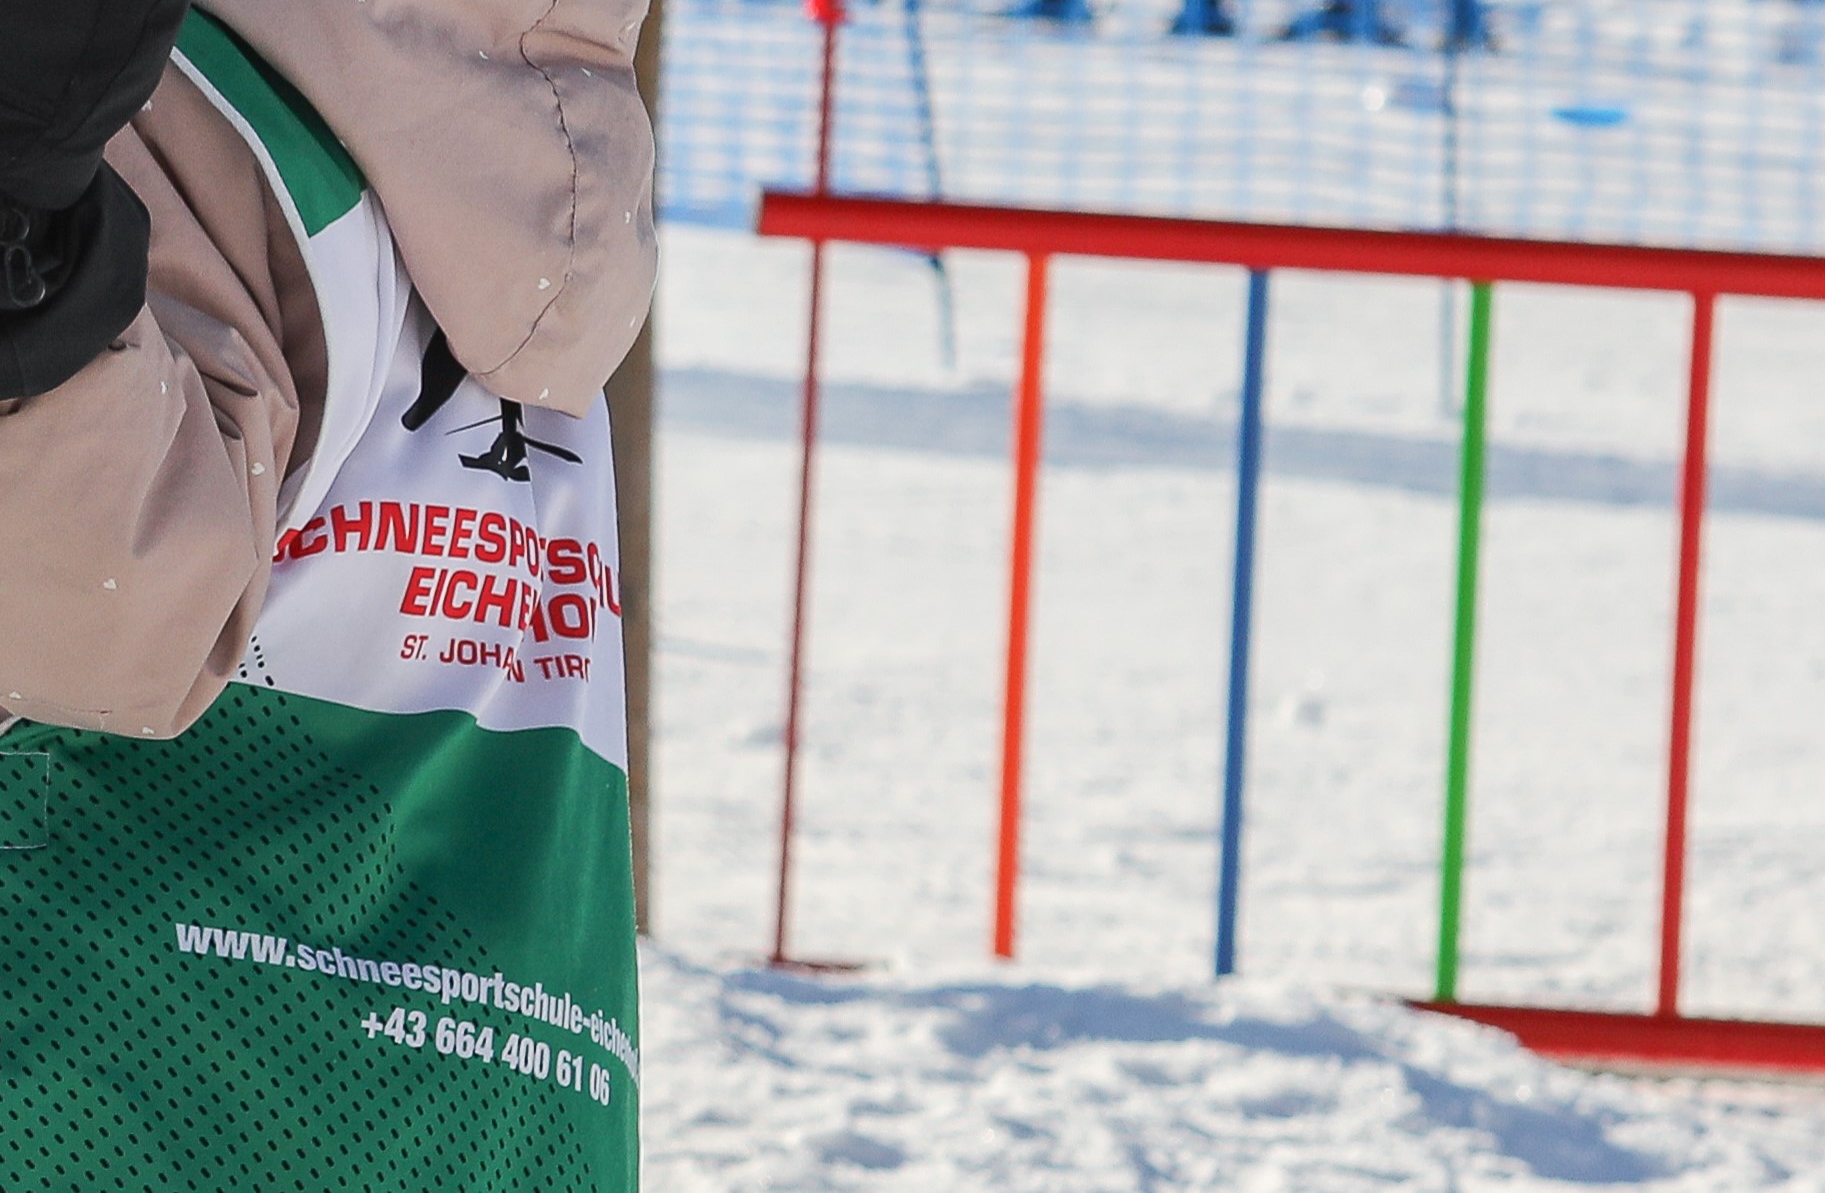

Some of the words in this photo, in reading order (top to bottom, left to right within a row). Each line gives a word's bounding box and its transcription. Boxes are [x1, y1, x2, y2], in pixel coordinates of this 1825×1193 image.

[400, 635, 428, 660] ST.
[360, 1007, 428, 1048] +43
[435, 1017, 494, 1064] 664
[501, 1033, 551, 1080] 400
[556, 1049, 583, 1093] 61
[589, 1063, 610, 1106] 06
